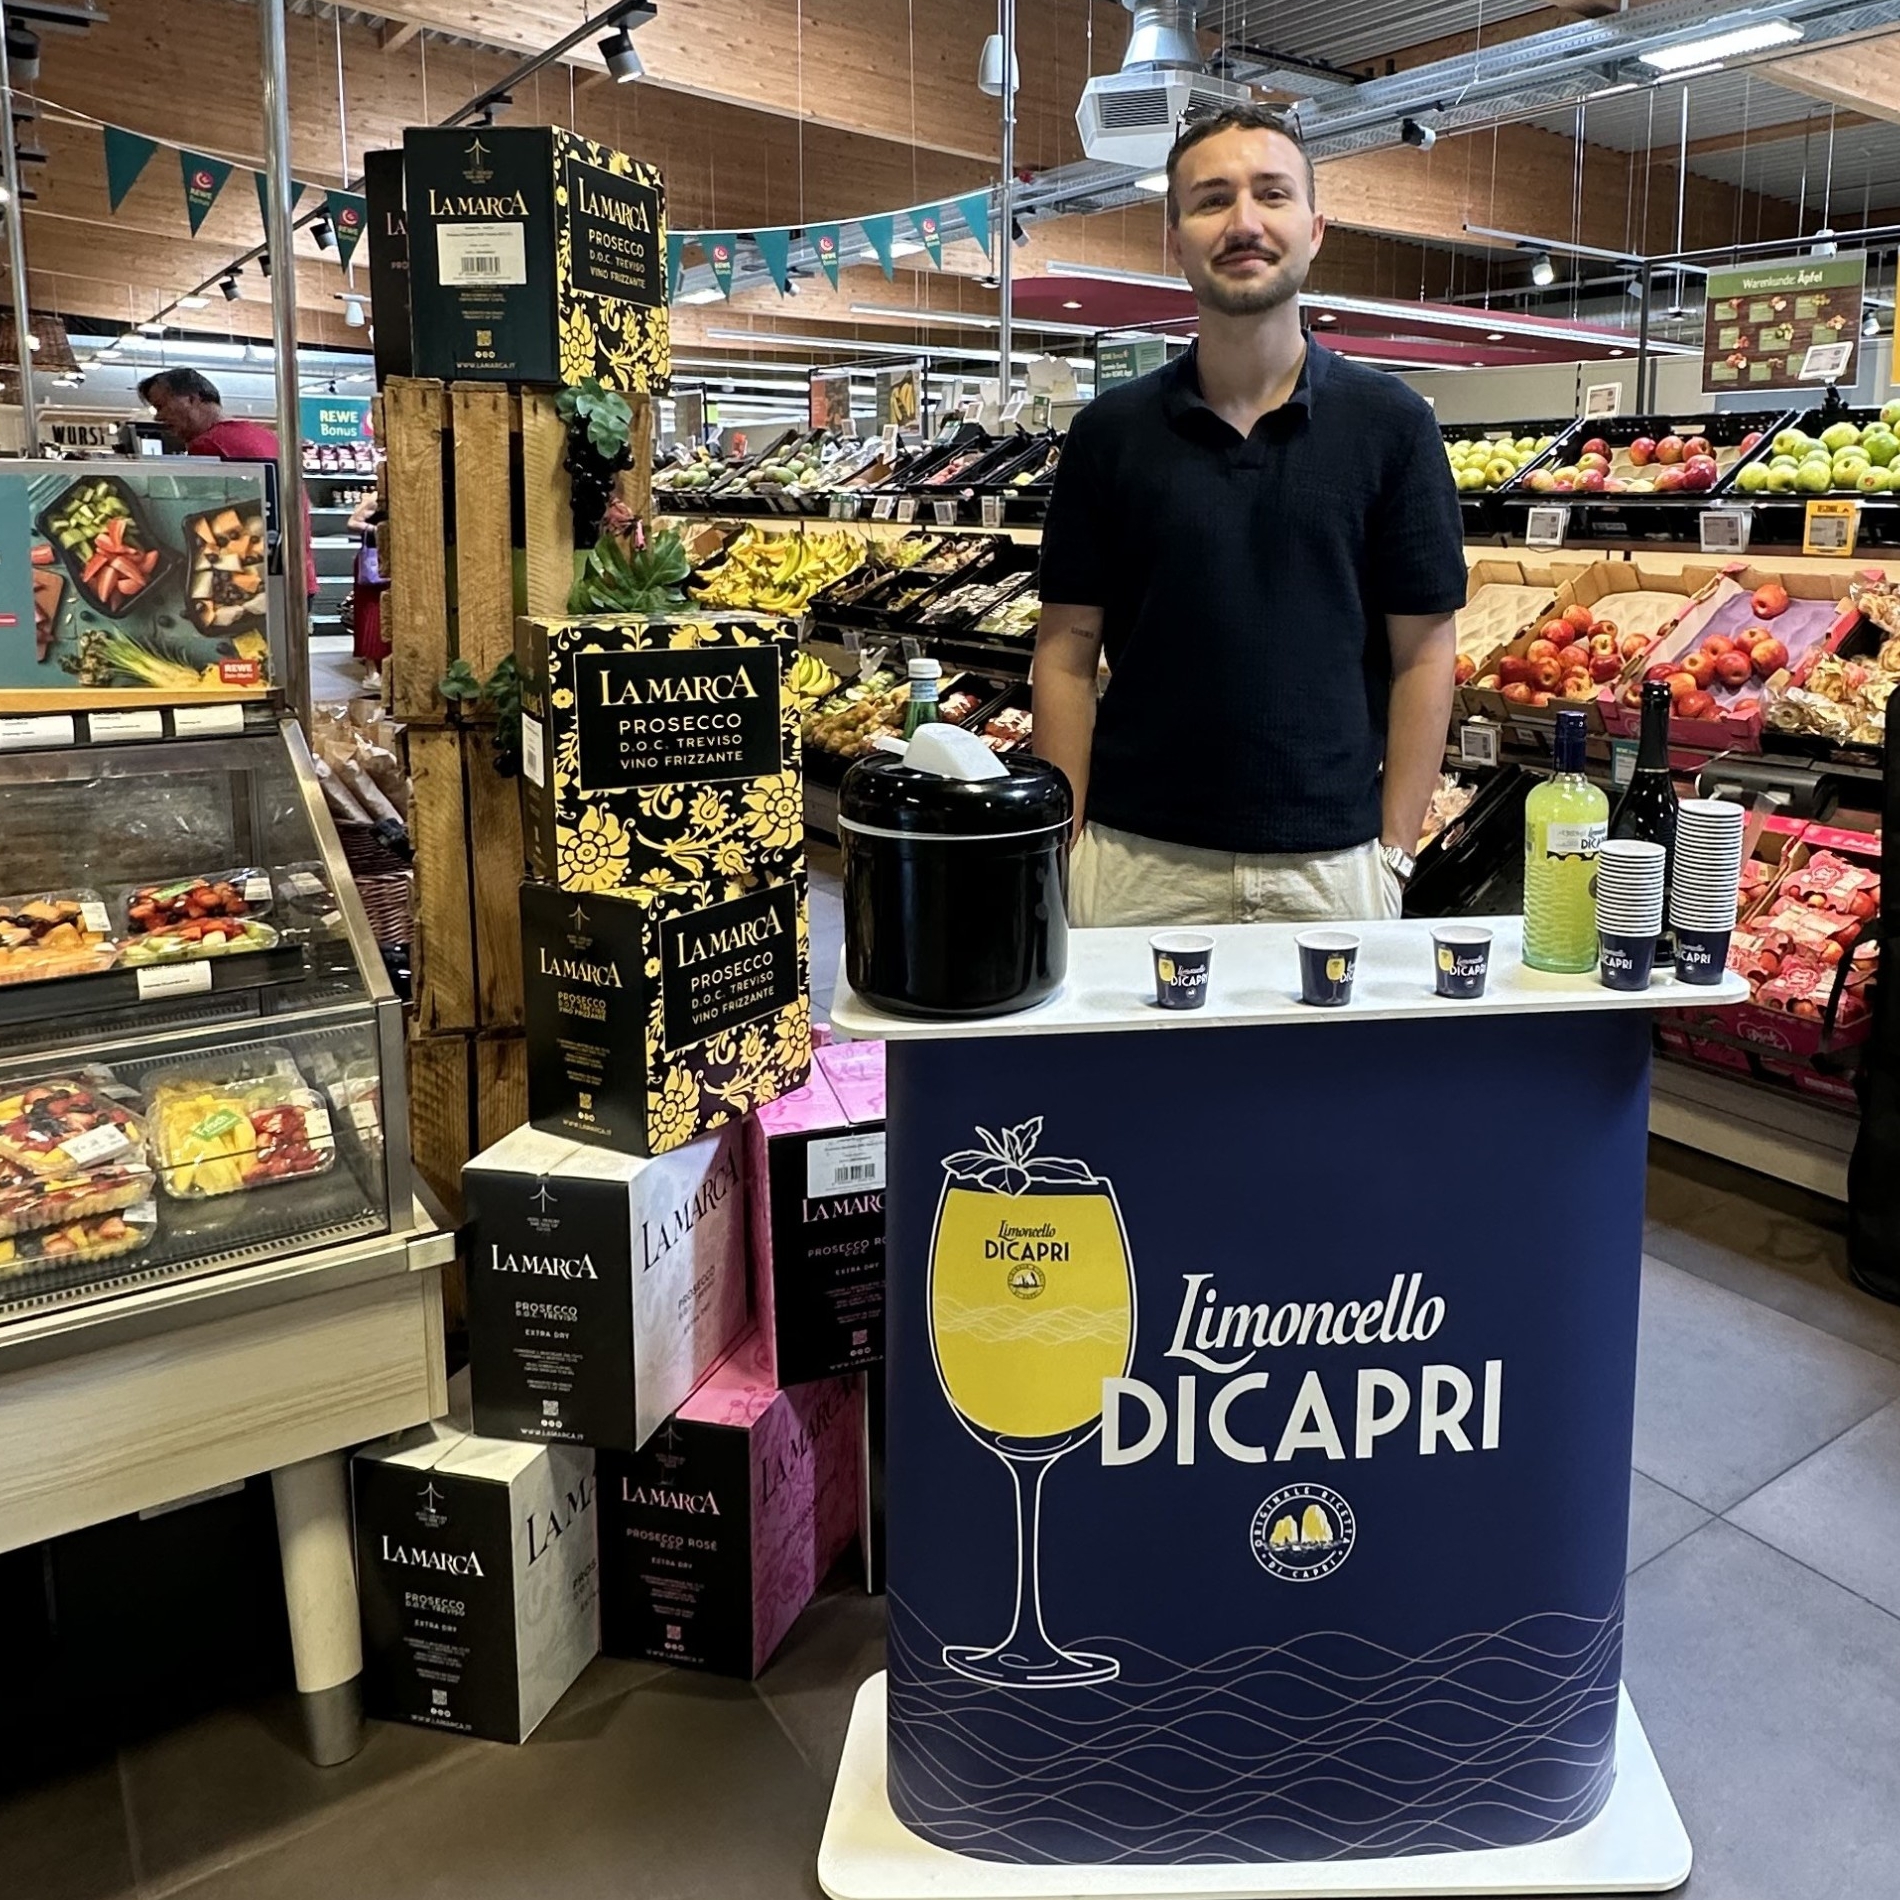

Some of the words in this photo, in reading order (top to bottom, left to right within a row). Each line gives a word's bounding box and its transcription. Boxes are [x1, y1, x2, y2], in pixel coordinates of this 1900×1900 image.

[428, 189, 454, 217] LA
[456, 189, 530, 218] MARCA
[577, 176, 601, 217] LA
[600, 194, 652, 234] MARCA
[587, 228, 645, 259] PROSECCO
[589, 265, 610, 280] VINO
[610, 270, 647, 289] FRIZZANTE
[615, 256, 646, 274] TREVISO
[1797, 269, 1823, 286] Äpfel
[319, 409, 359, 424] REWE
[320, 422, 358, 437] Bonus
[599, 669, 649, 707] LA
[646, 664, 759, 704] MARCA
[619, 712, 743, 736] PROSECCO
[619, 739, 670, 754] D.O.C.
[676, 733, 743, 750] TREVISO
[620, 756, 659, 770] VINO
[664, 749, 744, 767] FRIZZANTE
[676, 931, 708, 968] LA
[708, 904, 784, 958] MARCA
[539, 947, 562, 977] LA
[562, 959, 623, 988] MARCA
[690, 951, 774, 993] PROSECCO
[557, 991, 607, 1009] PROSECCO
[691, 988, 726, 1010] D.O.C.
[729, 970, 774, 994] TREVISO
[691, 1008, 719, 1025] VINO
[722, 985, 775, 1015] FRIZZANTE
[641, 1219, 672, 1274] LA
[671, 1146, 740, 1244] MARCA
[802, 1197, 830, 1224] LA
[831, 1195, 886, 1219] MARC
[998, 1219, 1056, 1242] Limoncello
[807, 1239, 870, 1258] PROSECCO
[985, 1239, 1069, 1262] DICAPRI
[491, 1243, 520, 1273] LA
[521, 1253, 599, 1281] MARCA
[515, 1300, 578, 1316] PROSECCO
[524, 1328, 551, 1338] EXTRA
[553, 1330, 570, 1340] DRY
[1164, 1272, 1446, 1374] Limoncello
[1101, 1359, 1503, 1467] DICAPRI
[621, 1476, 648, 1505] LA
[649, 1489, 721, 1516] MARCA
[1253, 1486, 1310, 1548] ORIGINALE
[1321, 1490, 1351, 1545] RICETTA
[626, 1527, 684, 1547] PROSECCO
[687, 1535, 718, 1551] ROSÉ
[381, 1534, 408, 1564] LA
[410, 1547, 485, 1578] MARCA
[651, 1556, 676, 1567] EXTRA
[677, 1559, 694, 1569] DRY
[1267, 1561, 1283, 1574] DI
[1292, 1559, 1336, 1578] CAPRI
[405, 1591, 466, 1611] PROSECCO
[414, 1618, 440, 1630] EXTRA
